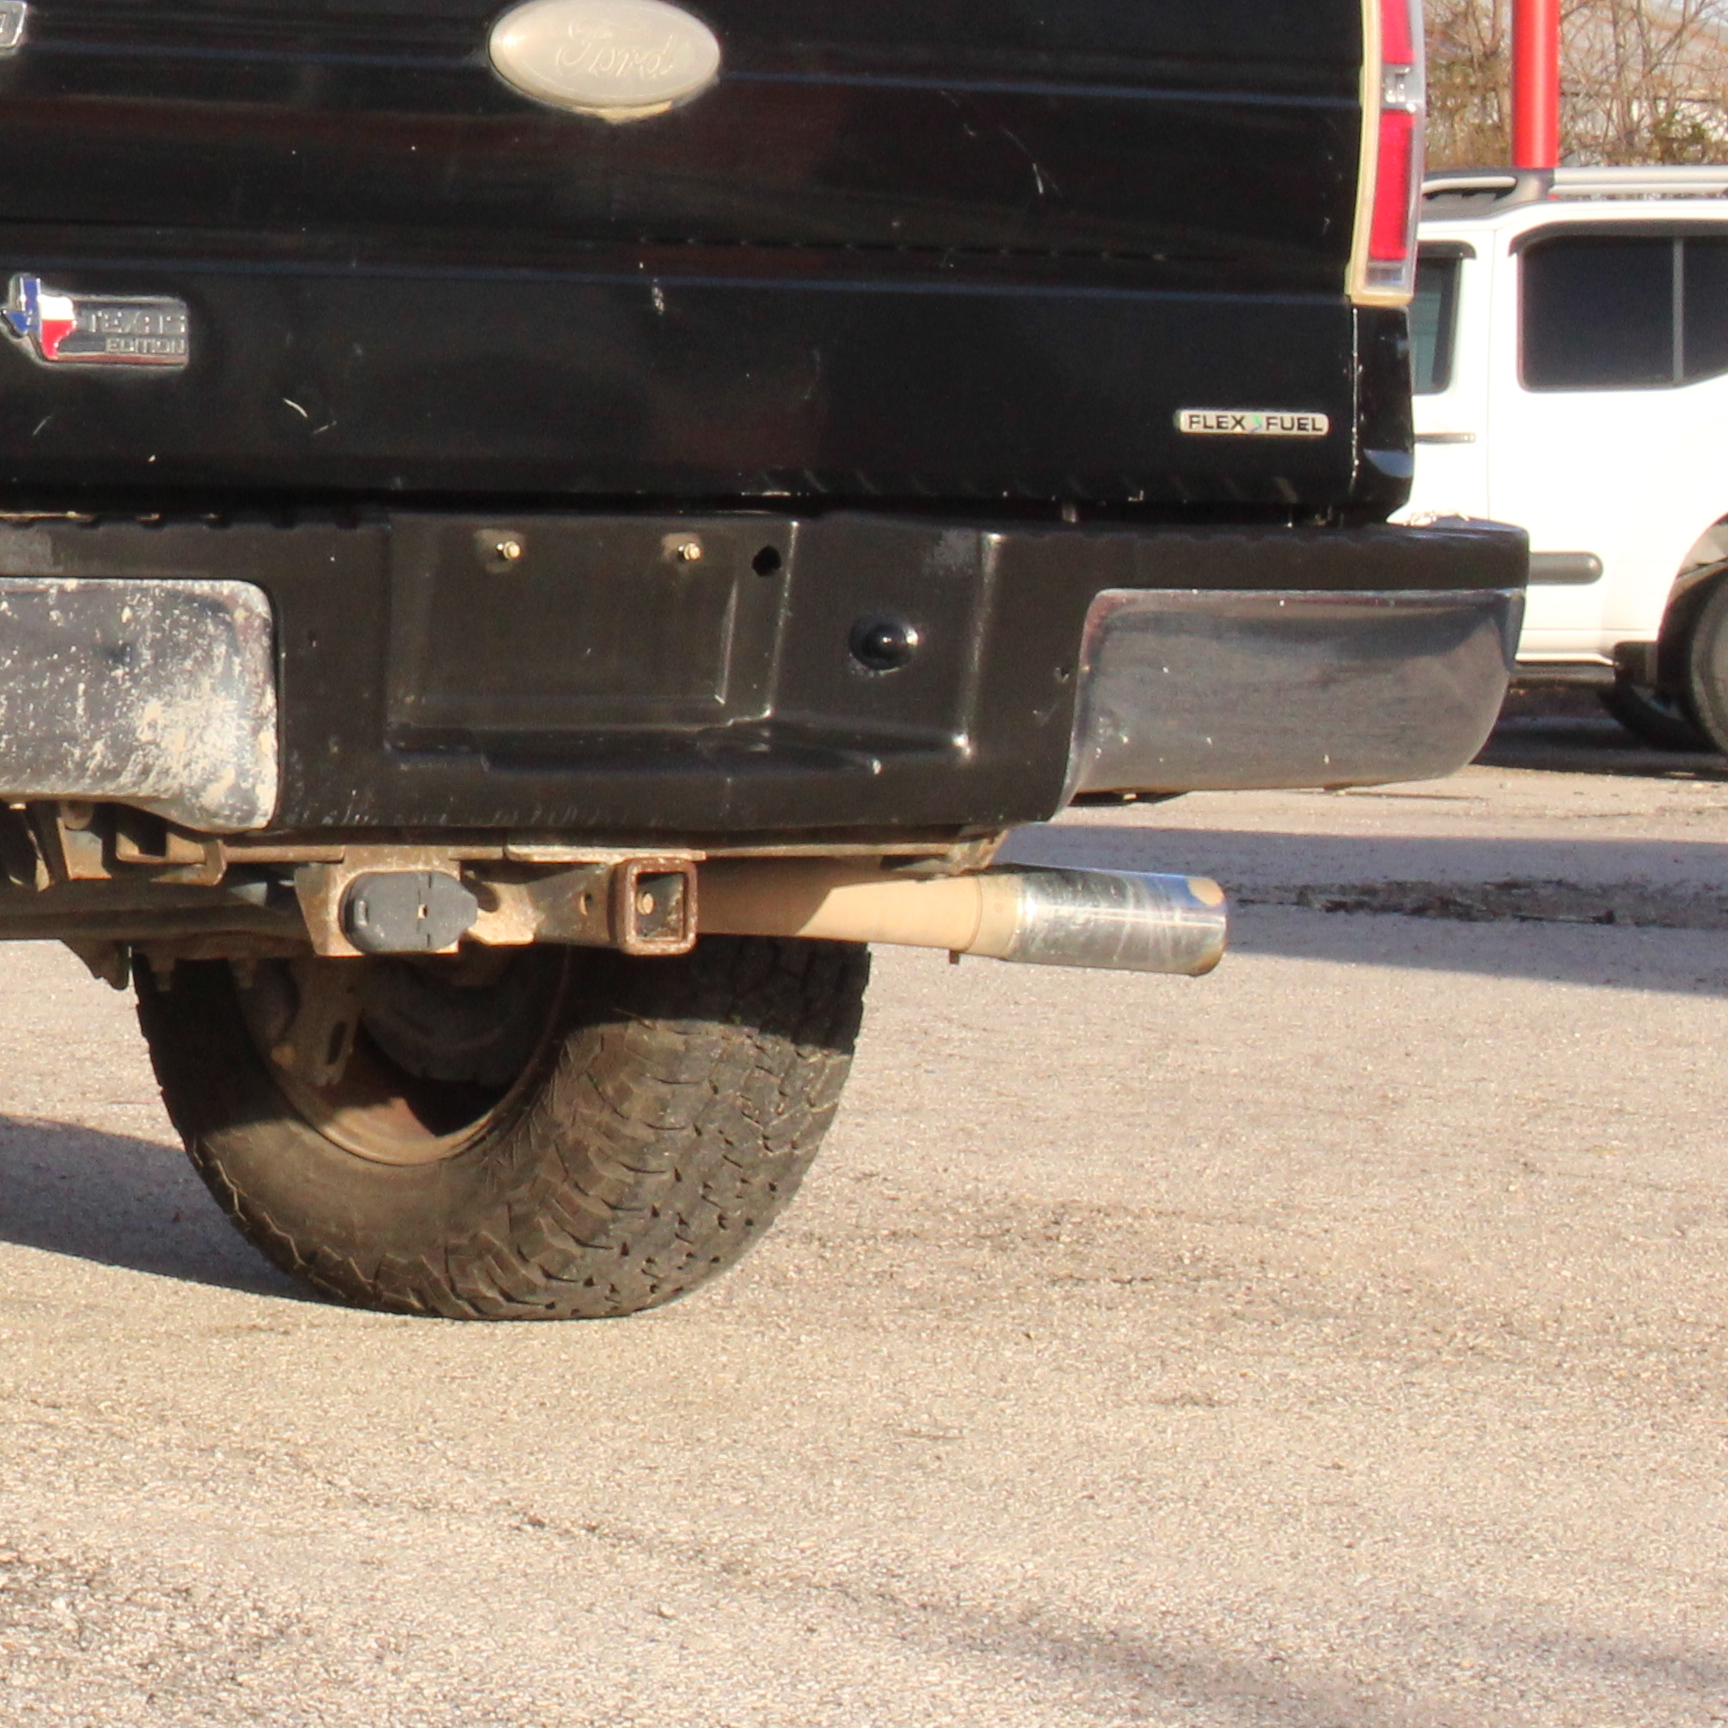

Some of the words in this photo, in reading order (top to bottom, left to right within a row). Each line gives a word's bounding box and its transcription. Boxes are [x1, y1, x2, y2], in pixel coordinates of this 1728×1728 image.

[555, 17, 679, 79] Ford
[104, 337, 185, 354] EDITION
[1188, 413, 1246, 431] FLEX
[1265, 415, 1324, 432] FUEL
